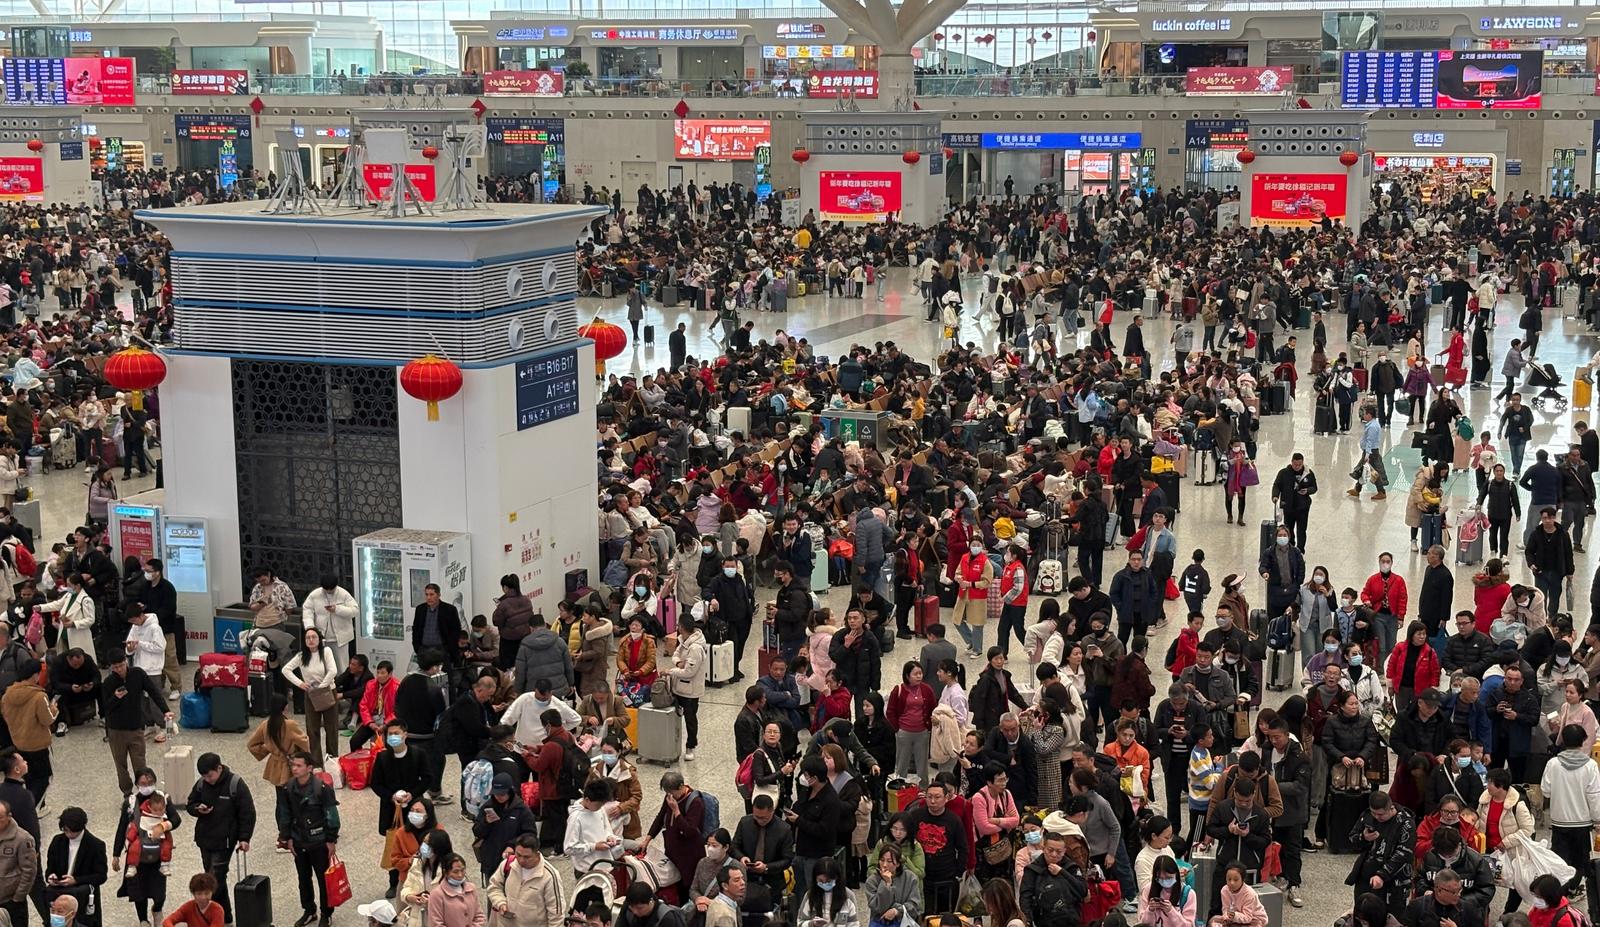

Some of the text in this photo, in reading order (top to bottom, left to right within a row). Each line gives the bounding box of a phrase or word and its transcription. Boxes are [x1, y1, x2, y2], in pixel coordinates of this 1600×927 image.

[1152, 19, 1216, 31] luckin coffee
[1493, 17, 1554, 29] LAWSON
[591, 30, 607, 39] ICBC
[658, 29, 702, 40] 商务休息厅
[178, 128, 188, 136] A8
[239, 129, 250, 137] A9
[488, 132, 503, 142] A10
[549, 133, 564, 142] A11
[1188, 136, 1206, 145] A14
